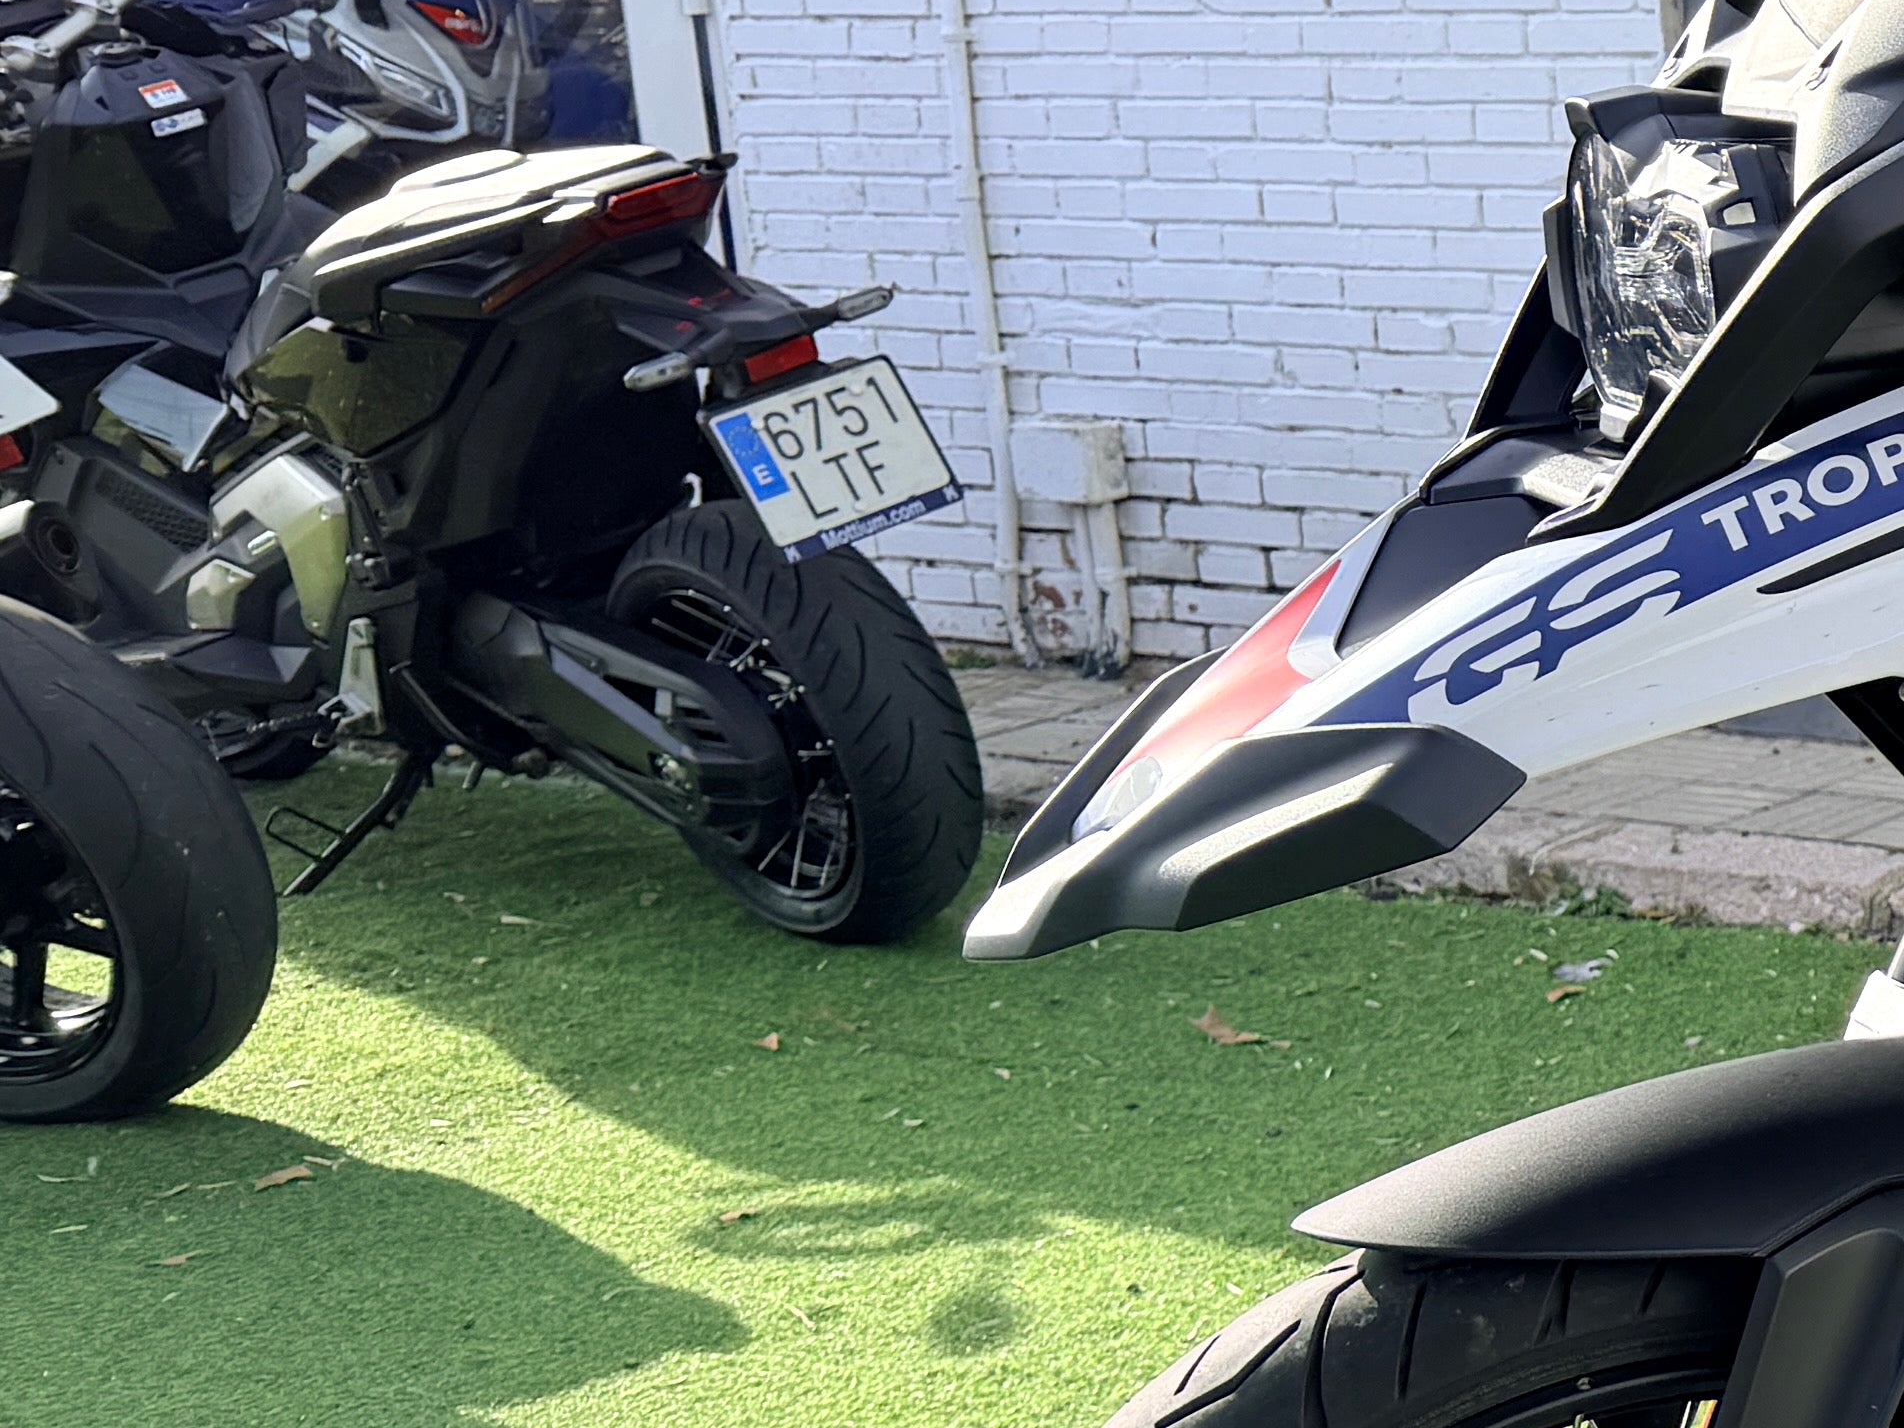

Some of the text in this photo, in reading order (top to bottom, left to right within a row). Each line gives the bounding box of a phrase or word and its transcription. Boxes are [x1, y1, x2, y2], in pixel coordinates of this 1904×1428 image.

[763, 376, 899, 461] 6751
[751, 463, 775, 487] E
[790, 440, 886, 520] LTF
[821, 500, 926, 551] Mottium.com
[1408, 528, 1681, 726] GS
